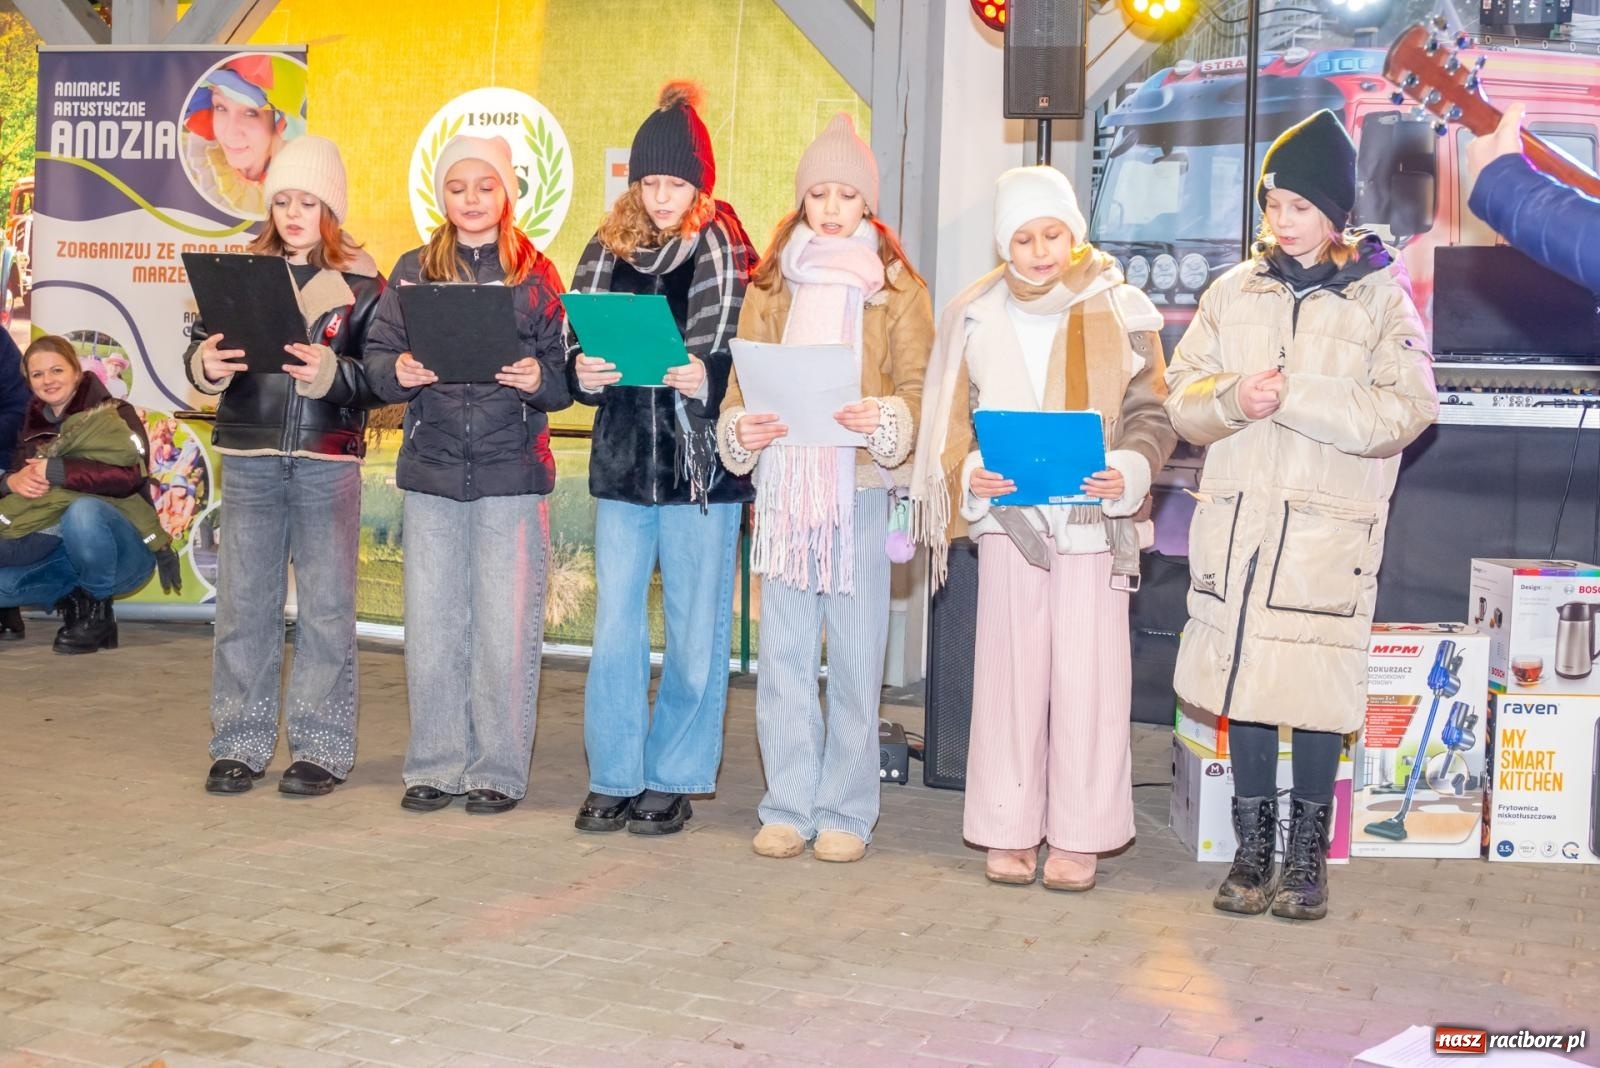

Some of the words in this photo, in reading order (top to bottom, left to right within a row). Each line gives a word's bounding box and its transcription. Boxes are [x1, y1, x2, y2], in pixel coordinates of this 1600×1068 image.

[1204, 58, 1245, 71] STRA
[54, 81, 121, 97] ANIMACJE
[54, 101, 146, 117] ARTYSTYCZNE
[467, 111, 520, 126] 1908
[51, 120, 177, 160] ANDZIA
[56, 240, 151, 260] ZORGANIZUJ
[156, 242, 175, 260] ZE
[132, 266, 187, 284] MARZE
[1372, 645, 1419, 654] MPM
[1368, 666, 1413, 674] ODKURZACZ
[1503, 702, 1558, 715] raven
[1501, 729, 1527, 748] MY
[1501, 750, 1556, 770] SMART
[1499, 771, 1564, 792] KITCHEN
[1498, 804, 1539, 813] Frytownica
